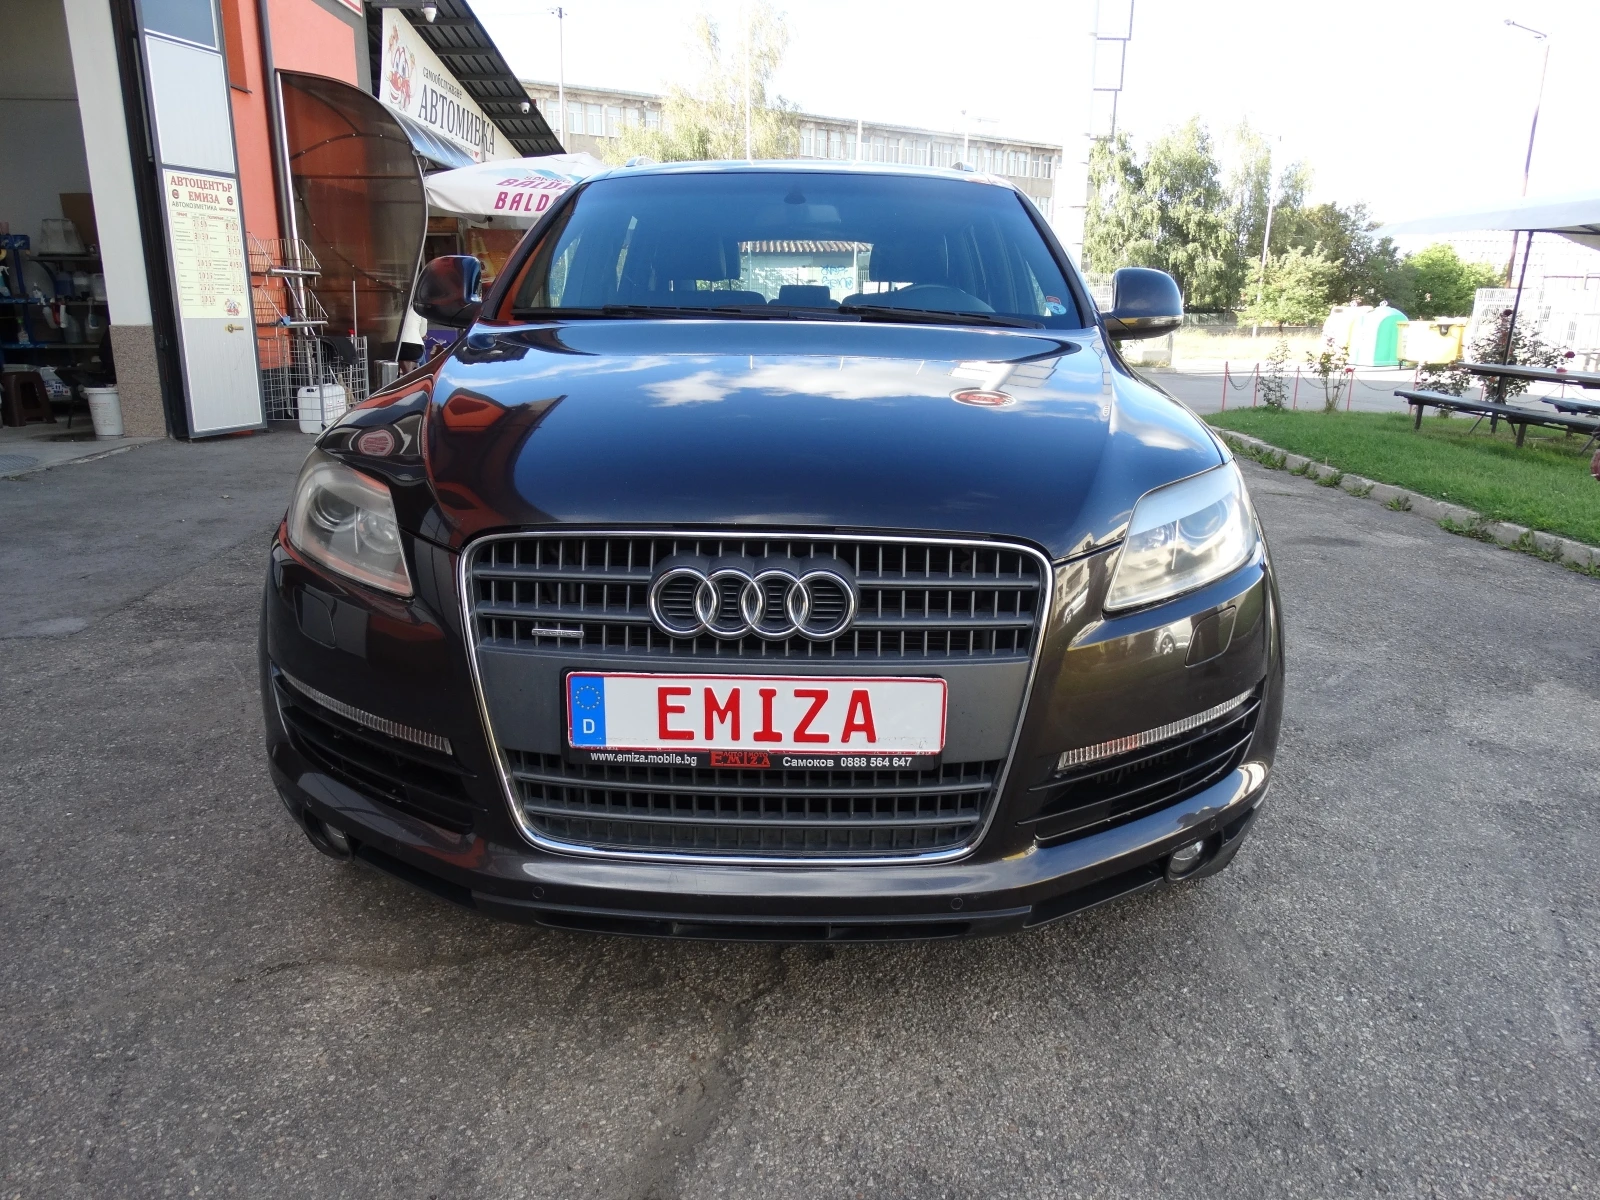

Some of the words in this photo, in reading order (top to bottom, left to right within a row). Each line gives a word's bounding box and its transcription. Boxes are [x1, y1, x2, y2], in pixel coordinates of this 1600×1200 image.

[418, 84, 495, 155] АВТОМИВКА
[170, 175, 233, 193] АВТОЦЕНТЪР
[188, 190, 220, 205] ЕМИЗА
[171, 200, 218, 212] АВТОКОЗМЕТИКА
[657, 686, 878, 744] EMIZA
[582, 718, 595, 734] D
[590, 752, 697, 767] www.emiza.mobile.bg
[710, 751, 770, 767] EMIZA
[782, 756, 835, 767] Самоков
[840, 757, 867, 767] 0888
[869, 757, 890, 767] 564
[892, 757, 912, 767] 647
